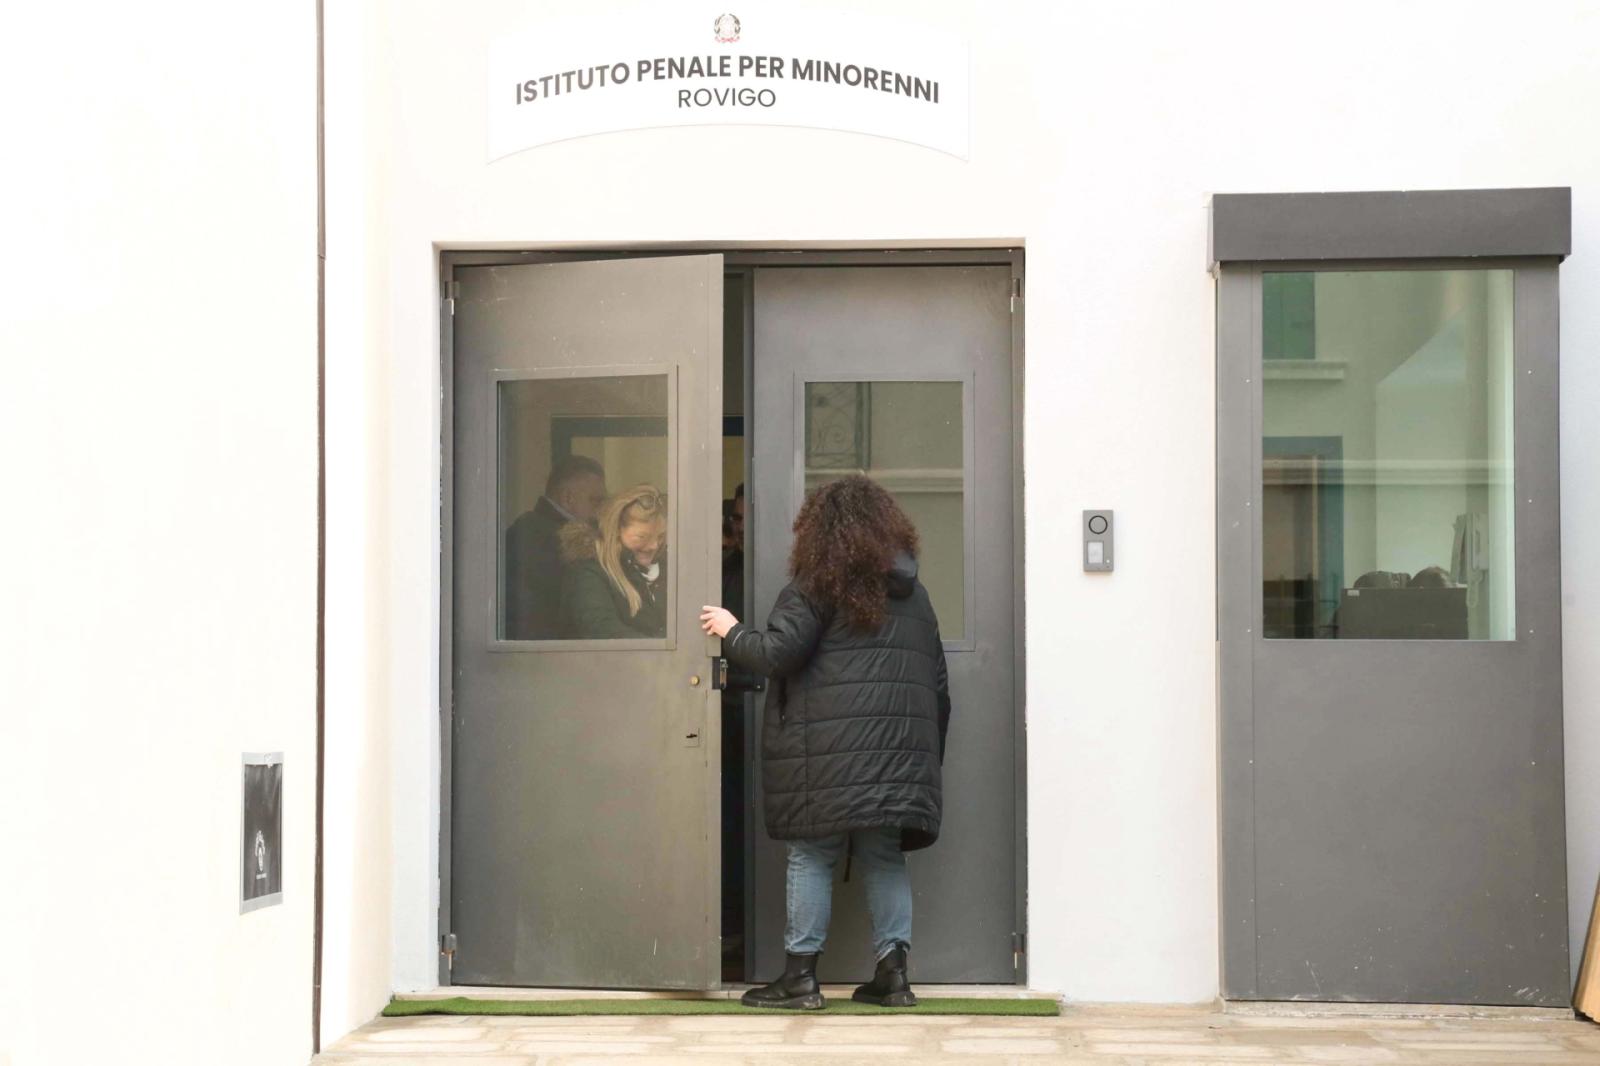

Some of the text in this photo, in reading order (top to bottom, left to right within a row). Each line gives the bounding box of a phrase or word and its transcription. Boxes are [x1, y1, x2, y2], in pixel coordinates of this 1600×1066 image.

[516, 55, 939, 105] ISTITUTO PENALE PER MINORENNI
[678, 87, 777, 108] ROVIGO
